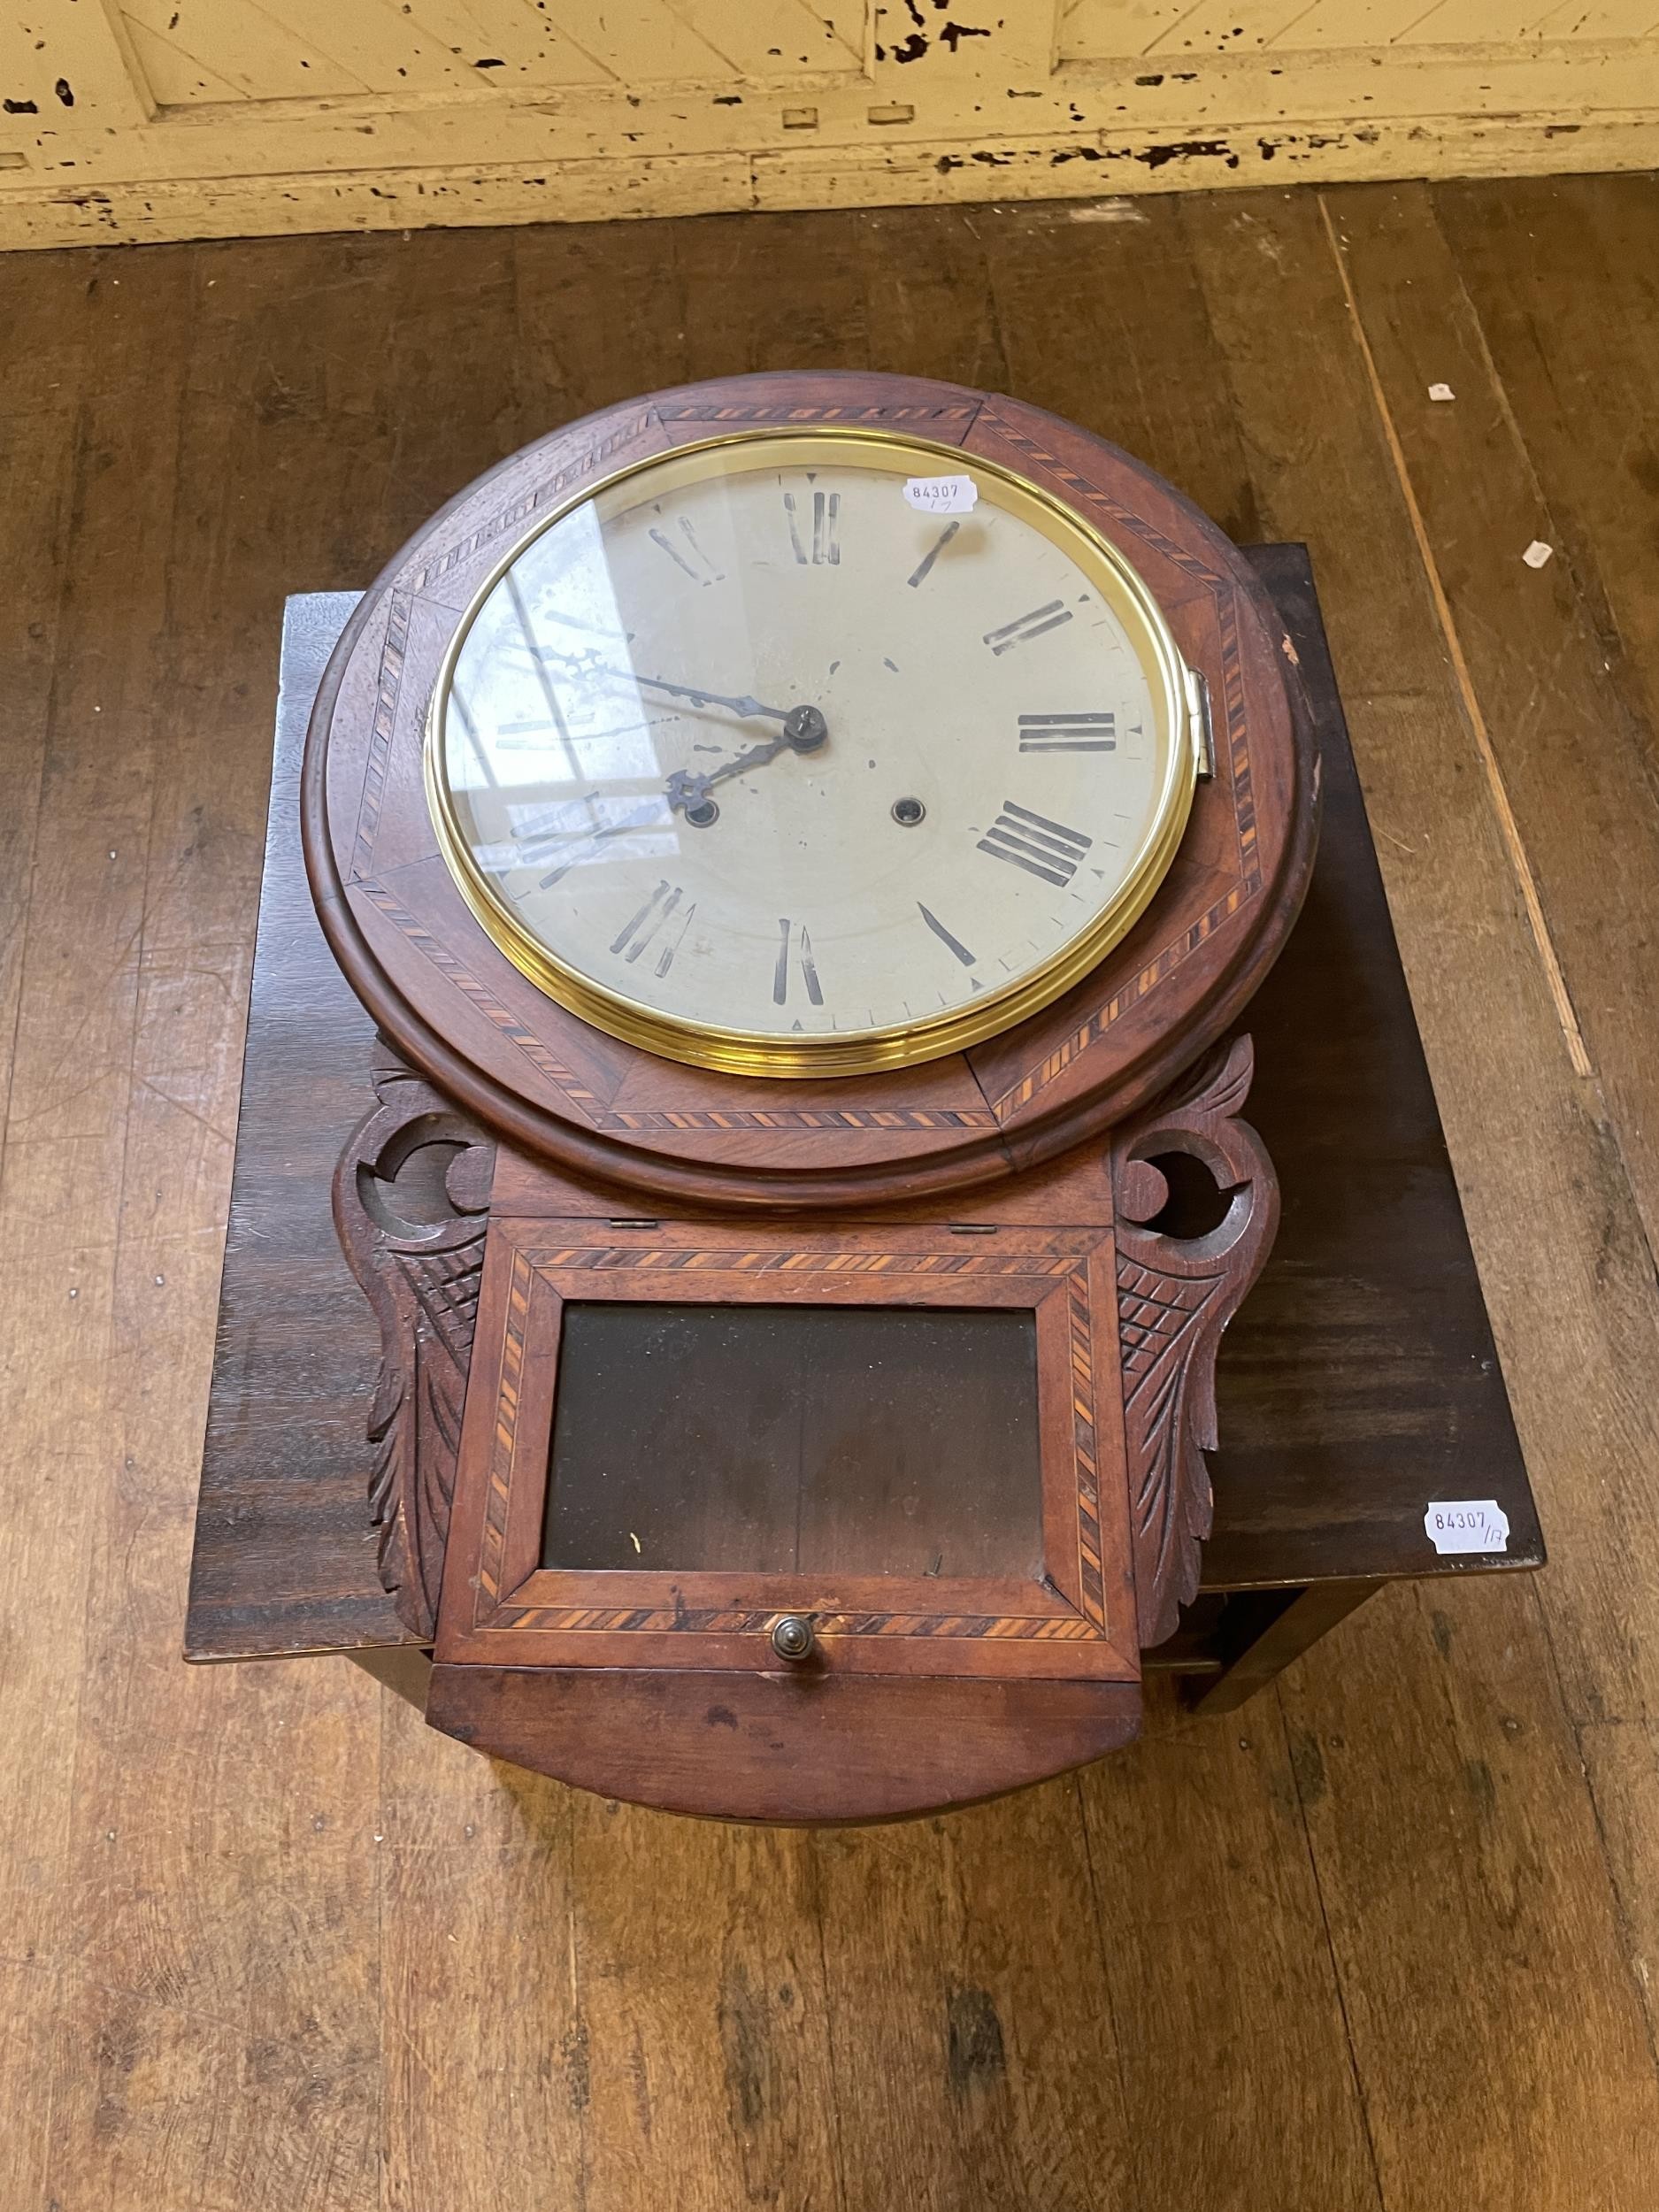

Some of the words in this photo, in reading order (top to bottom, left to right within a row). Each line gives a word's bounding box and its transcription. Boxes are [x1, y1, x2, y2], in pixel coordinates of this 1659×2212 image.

[913, 484, 958, 498] 84307
[983, 599, 1073, 657] II
[1018, 712, 1117, 753] III
[976, 800, 1094, 888] IIII
[1435, 1512, 1486, 1530] 84307
